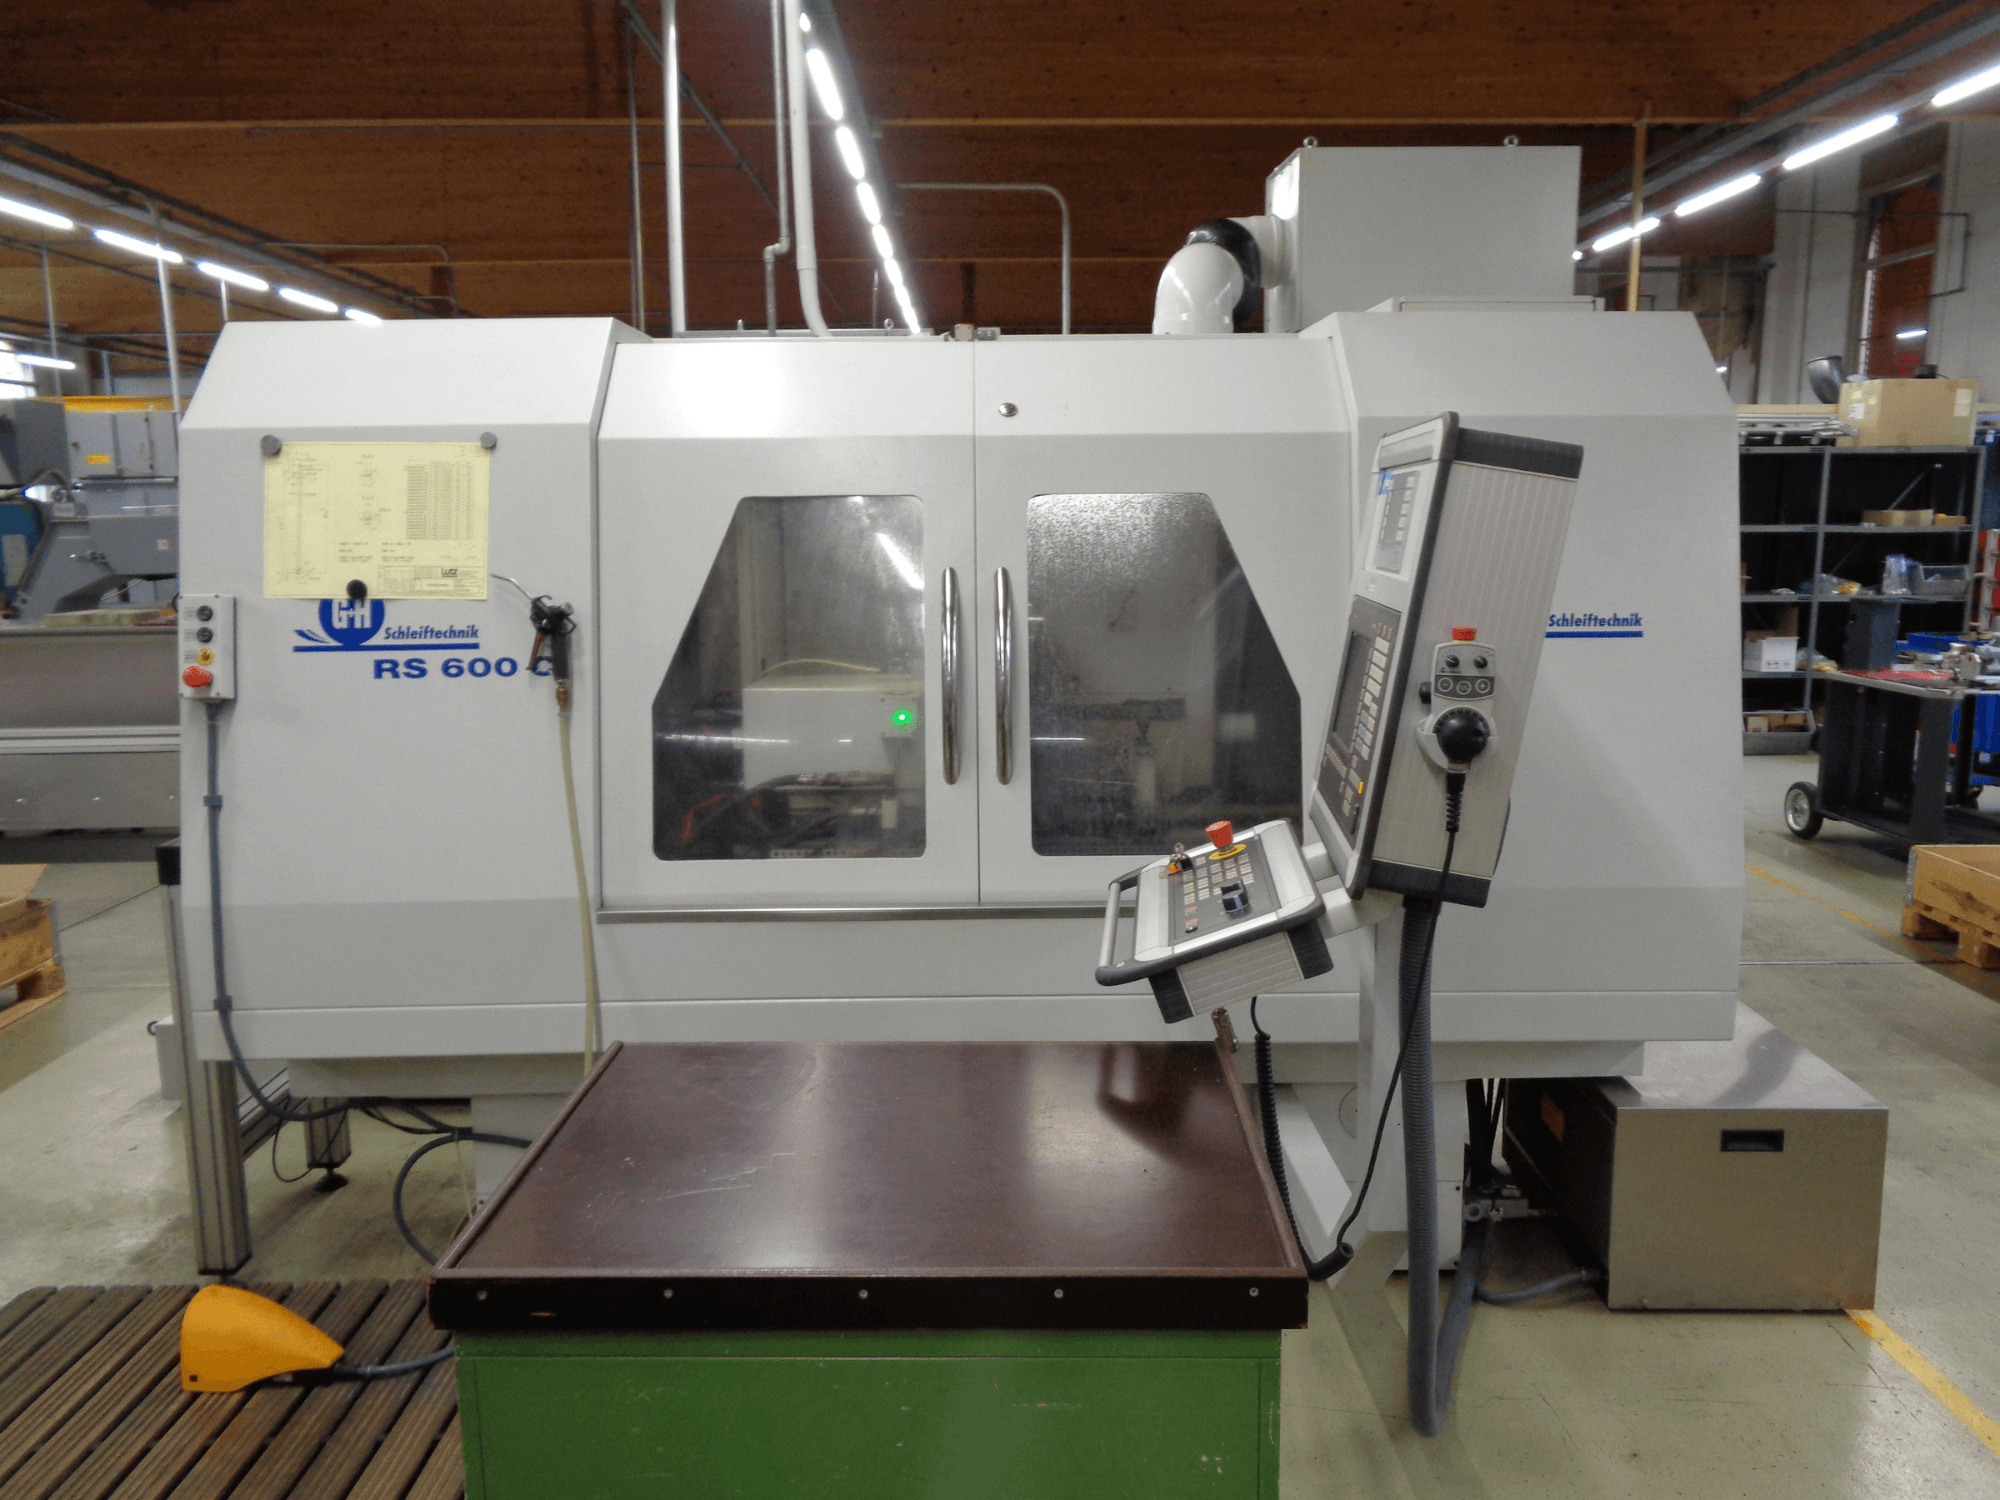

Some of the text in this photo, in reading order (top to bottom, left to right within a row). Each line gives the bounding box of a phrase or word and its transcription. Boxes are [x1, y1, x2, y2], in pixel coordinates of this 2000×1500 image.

[1549, 613, 1643, 627] Schleiftechnik
[384, 624, 479, 640] Schleiftechnik
[373, 657, 428, 680] RS
[441, 656, 518, 678] 600
